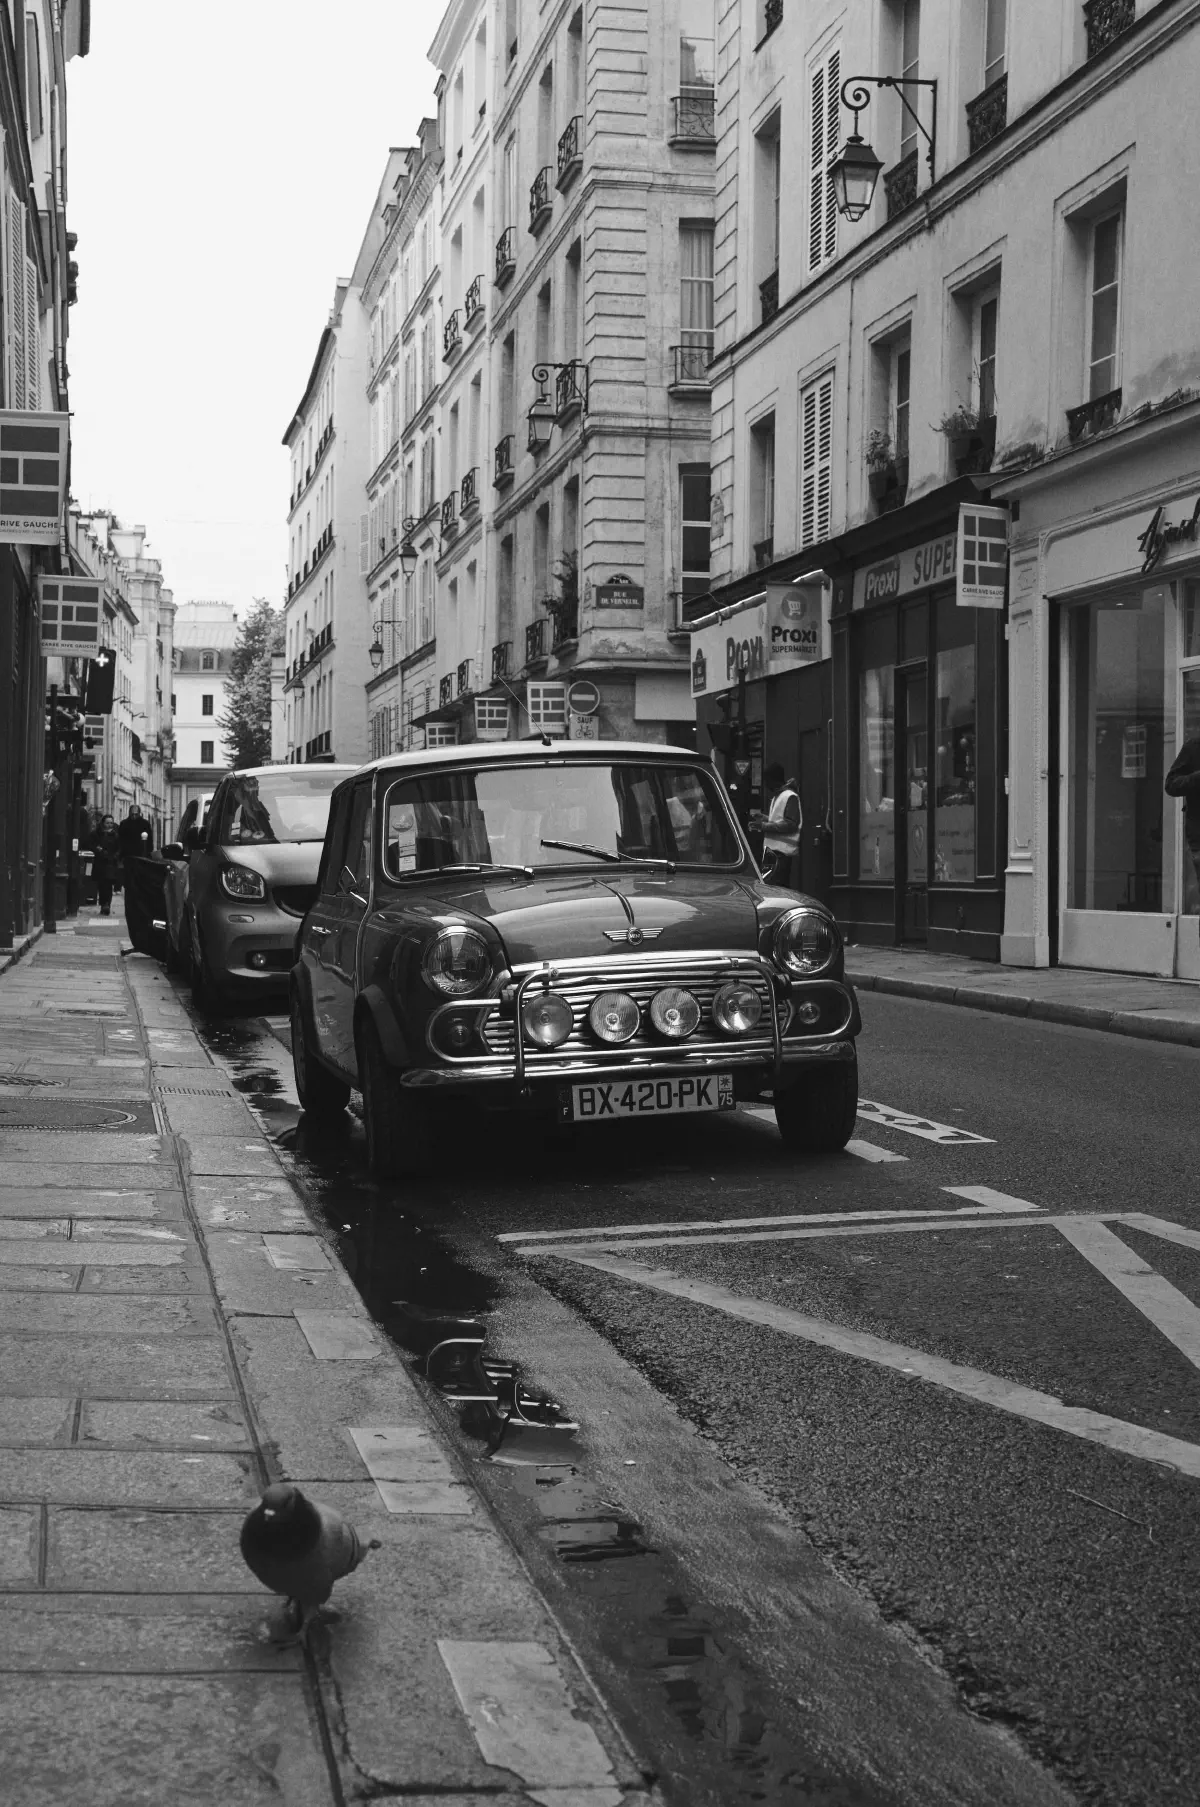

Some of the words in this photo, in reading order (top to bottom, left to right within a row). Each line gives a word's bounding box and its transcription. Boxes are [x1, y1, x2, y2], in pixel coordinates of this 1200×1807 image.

[23, 521, 59, 529] GAUCHE
[866, 562, 899, 600] Proxi
[771, 621, 818, 644] Proxi
[772, 645, 817, 654] SUPERMARKET
[726, 635, 764, 681] Proxi
[576, 716, 594, 724] SAUF
[579, 1078, 713, 1116] BX-420-PK
[719, 1091, 733, 1106] 75
[562, 1107, 569, 1116] F
